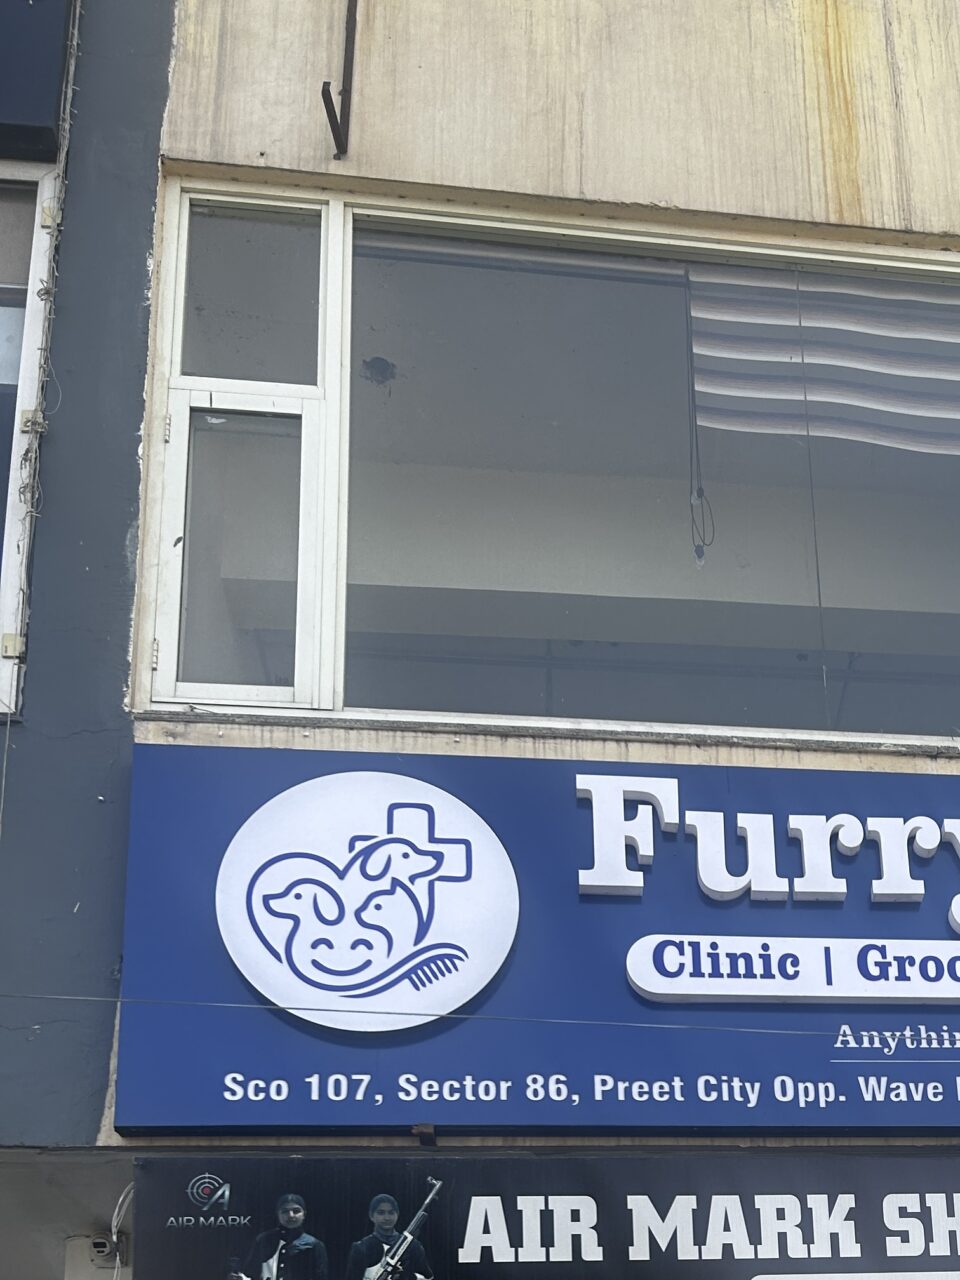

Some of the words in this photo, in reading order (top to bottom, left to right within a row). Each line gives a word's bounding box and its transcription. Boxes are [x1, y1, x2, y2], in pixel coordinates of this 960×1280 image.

[652, 939, 801, 981] Clinic
[222, 1072, 290, 1102] Sco
[304, 1073, 384, 1106] 107,
[397, 1073, 512, 1102] Sector
[524, 1073, 580, 1106] 86,
[593, 1074, 685, 1102] Preet
[696, 1074, 762, 1108] City
[773, 1074, 848, 1108] Opp.
[857, 1076, 944, 1102] Wave
[166, 1216, 195, 1228] AIR
[199, 1215, 252, 1227] MARK
[458, 1195, 604, 1264] AIR
[626, 1193, 862, 1261] MARK
